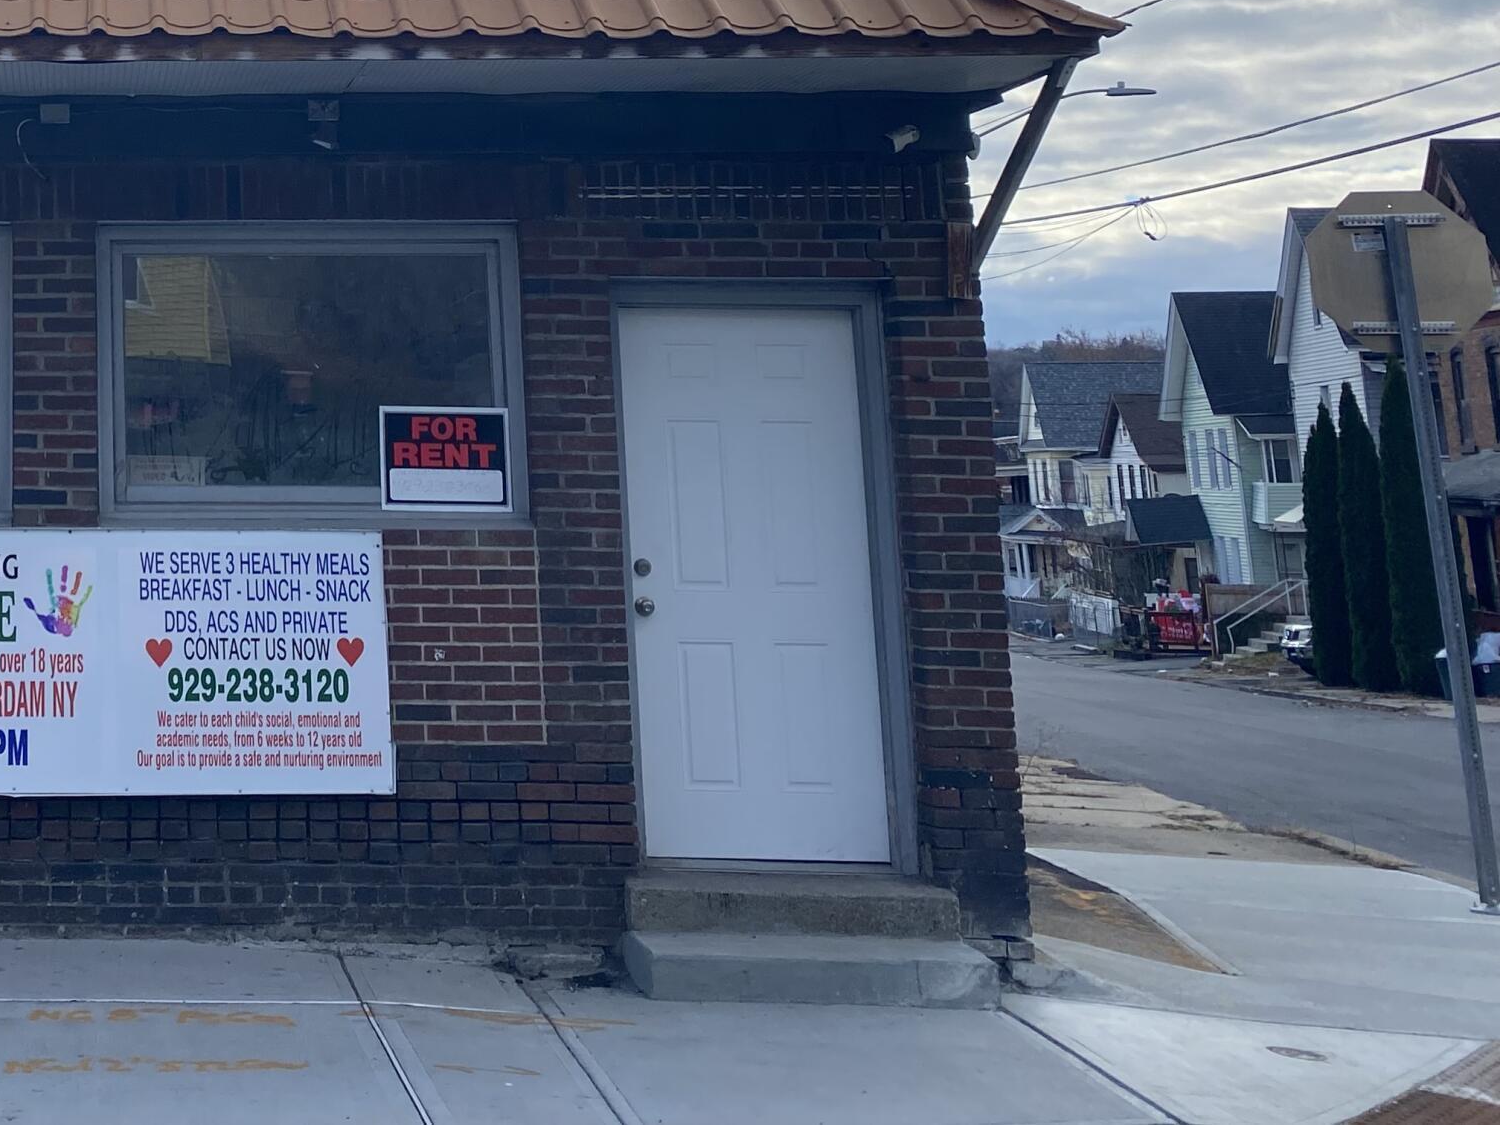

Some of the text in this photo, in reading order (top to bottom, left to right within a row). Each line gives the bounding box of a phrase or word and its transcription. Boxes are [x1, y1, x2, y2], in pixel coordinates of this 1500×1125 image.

[411, 417, 477, 441] FOR
[393, 443, 497, 467] RENT
[140, 552, 370, 575] WE SERVE 3 HEALTHY MEALS
[140, 579, 232, 601] BREAKFAST
[246, 579, 301, 601] LUNCH
[316, 579, 371, 602] SNACK
[164, 611, 348, 636] DDS, ACS AND PRIVATE
[184, 637, 330, 661] CONTACT US NOW
[0, 655, 26, 673] over
[30, 650, 45, 673] 18
[50, 655, 84, 678] years
[168, 667, 350, 703] 929-238-3120
[53, 681, 78, 717] NY
[157, 711, 360, 729] We cater to each child's social, emotional and
[156, 731, 362, 751] academic needs, from 6 weeks to 12 years old
[138, 750, 382, 770] Our goal is to provide a safe and nurturing environment
